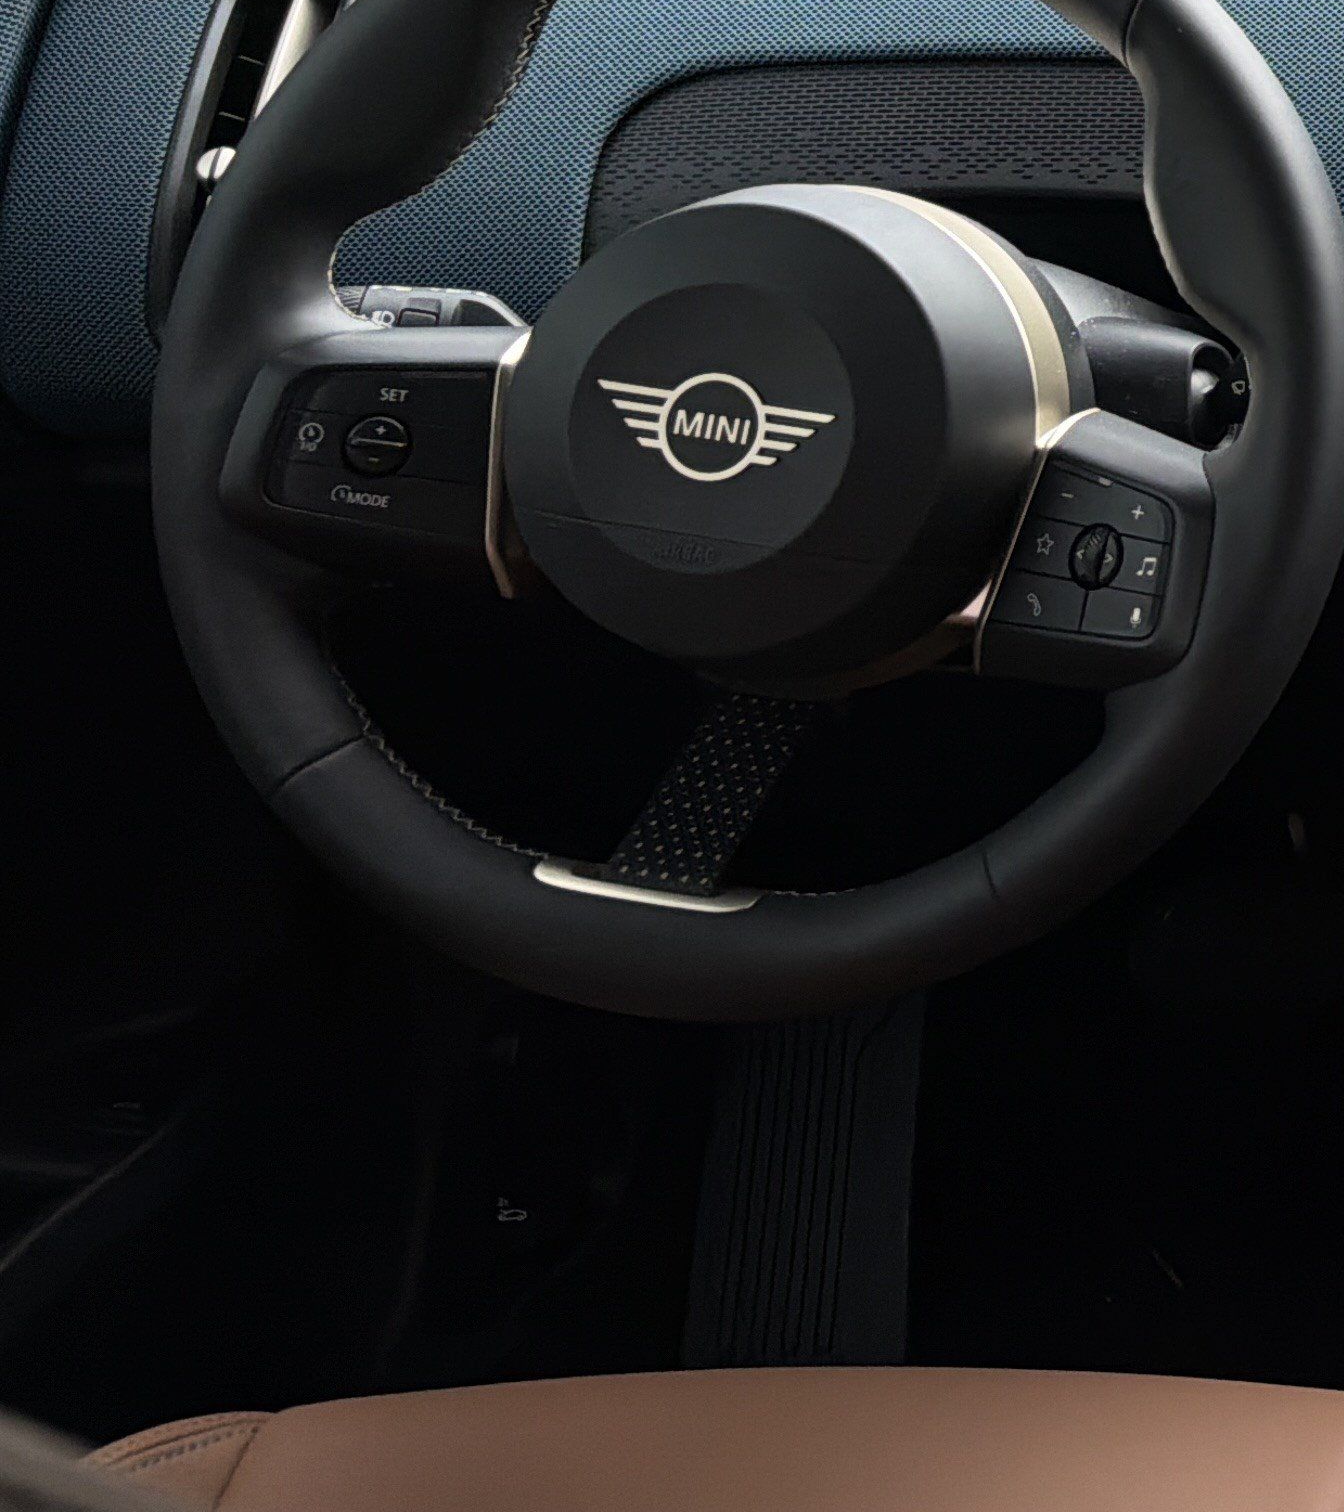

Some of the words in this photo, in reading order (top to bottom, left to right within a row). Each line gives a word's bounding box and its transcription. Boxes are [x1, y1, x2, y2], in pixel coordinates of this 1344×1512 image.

[380, 387, 409, 402] SET
[673, 409, 750, 445] MINI
[347, 491, 391, 508] MODE
